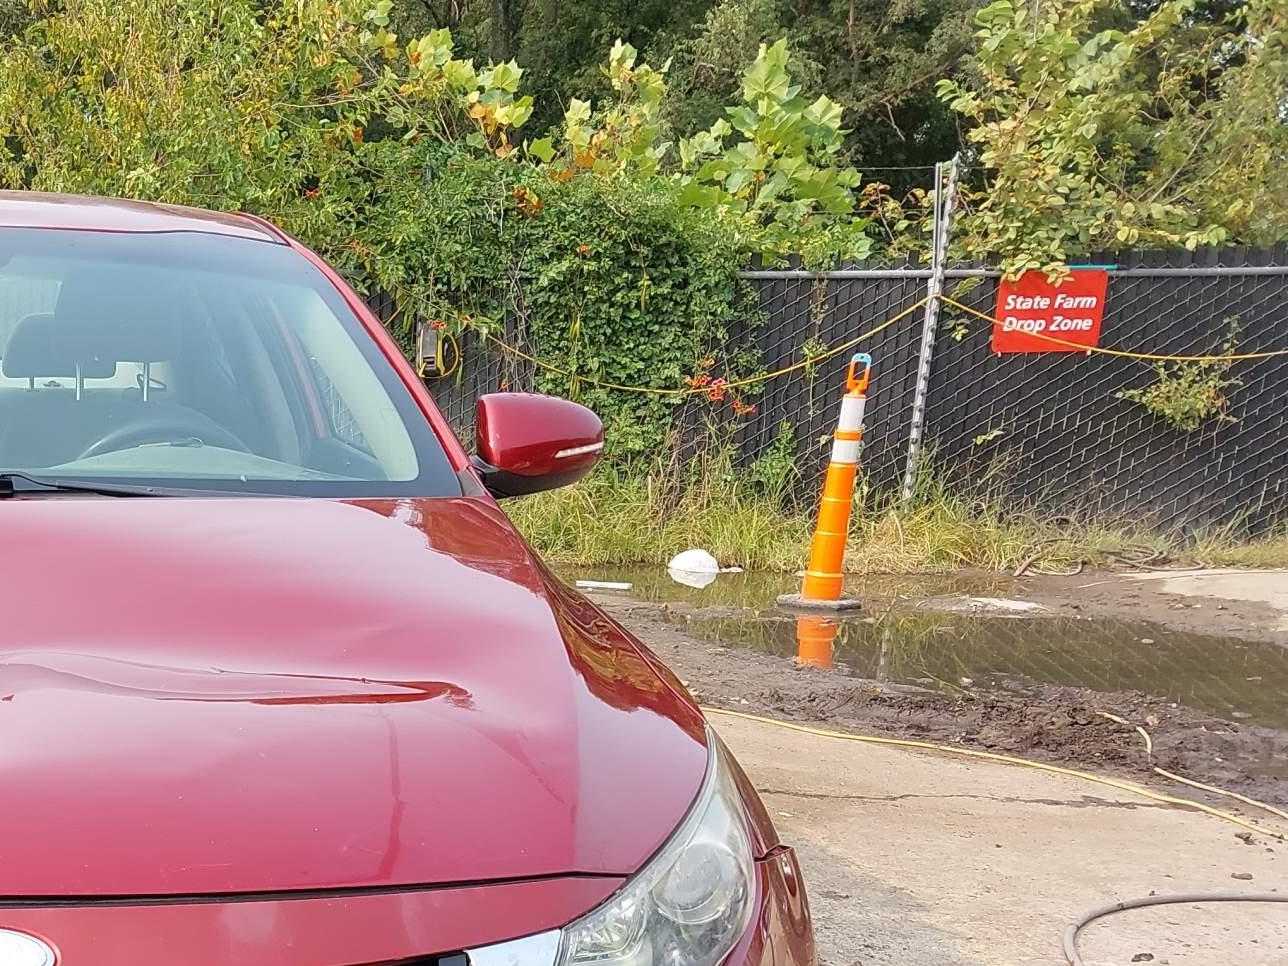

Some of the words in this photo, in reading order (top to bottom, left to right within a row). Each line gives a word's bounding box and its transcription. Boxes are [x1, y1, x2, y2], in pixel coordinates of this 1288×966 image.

[1004, 294, 1051, 310] State
[1054, 294, 1097, 309] Farm
[1003, 317, 1046, 334] Drop
[1049, 316, 1093, 331] Zone
